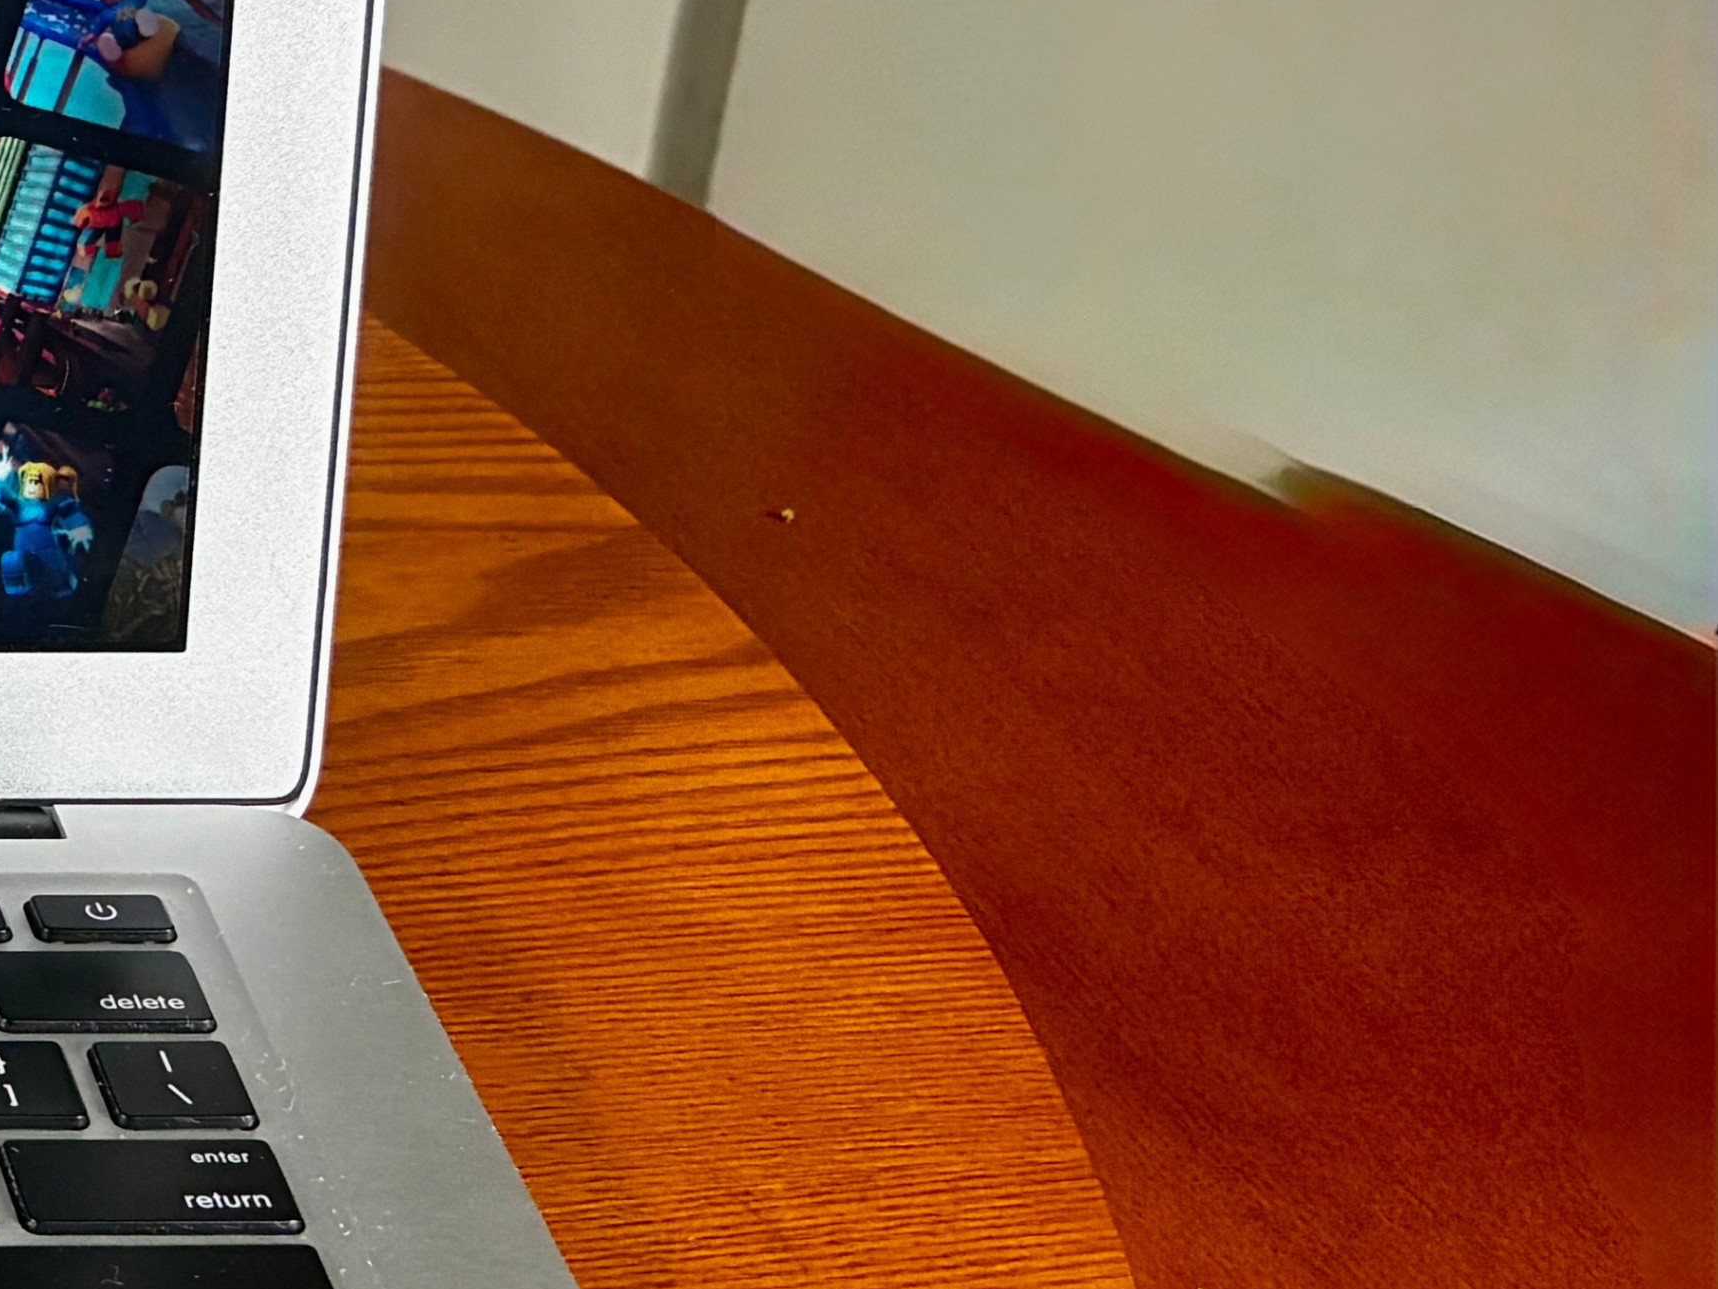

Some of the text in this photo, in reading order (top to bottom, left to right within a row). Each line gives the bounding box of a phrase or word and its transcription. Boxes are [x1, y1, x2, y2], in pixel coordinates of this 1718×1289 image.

[99, 994, 186, 1010] delete
[190, 1151, 249, 1164] enter
[184, 1191, 273, 1209] return
